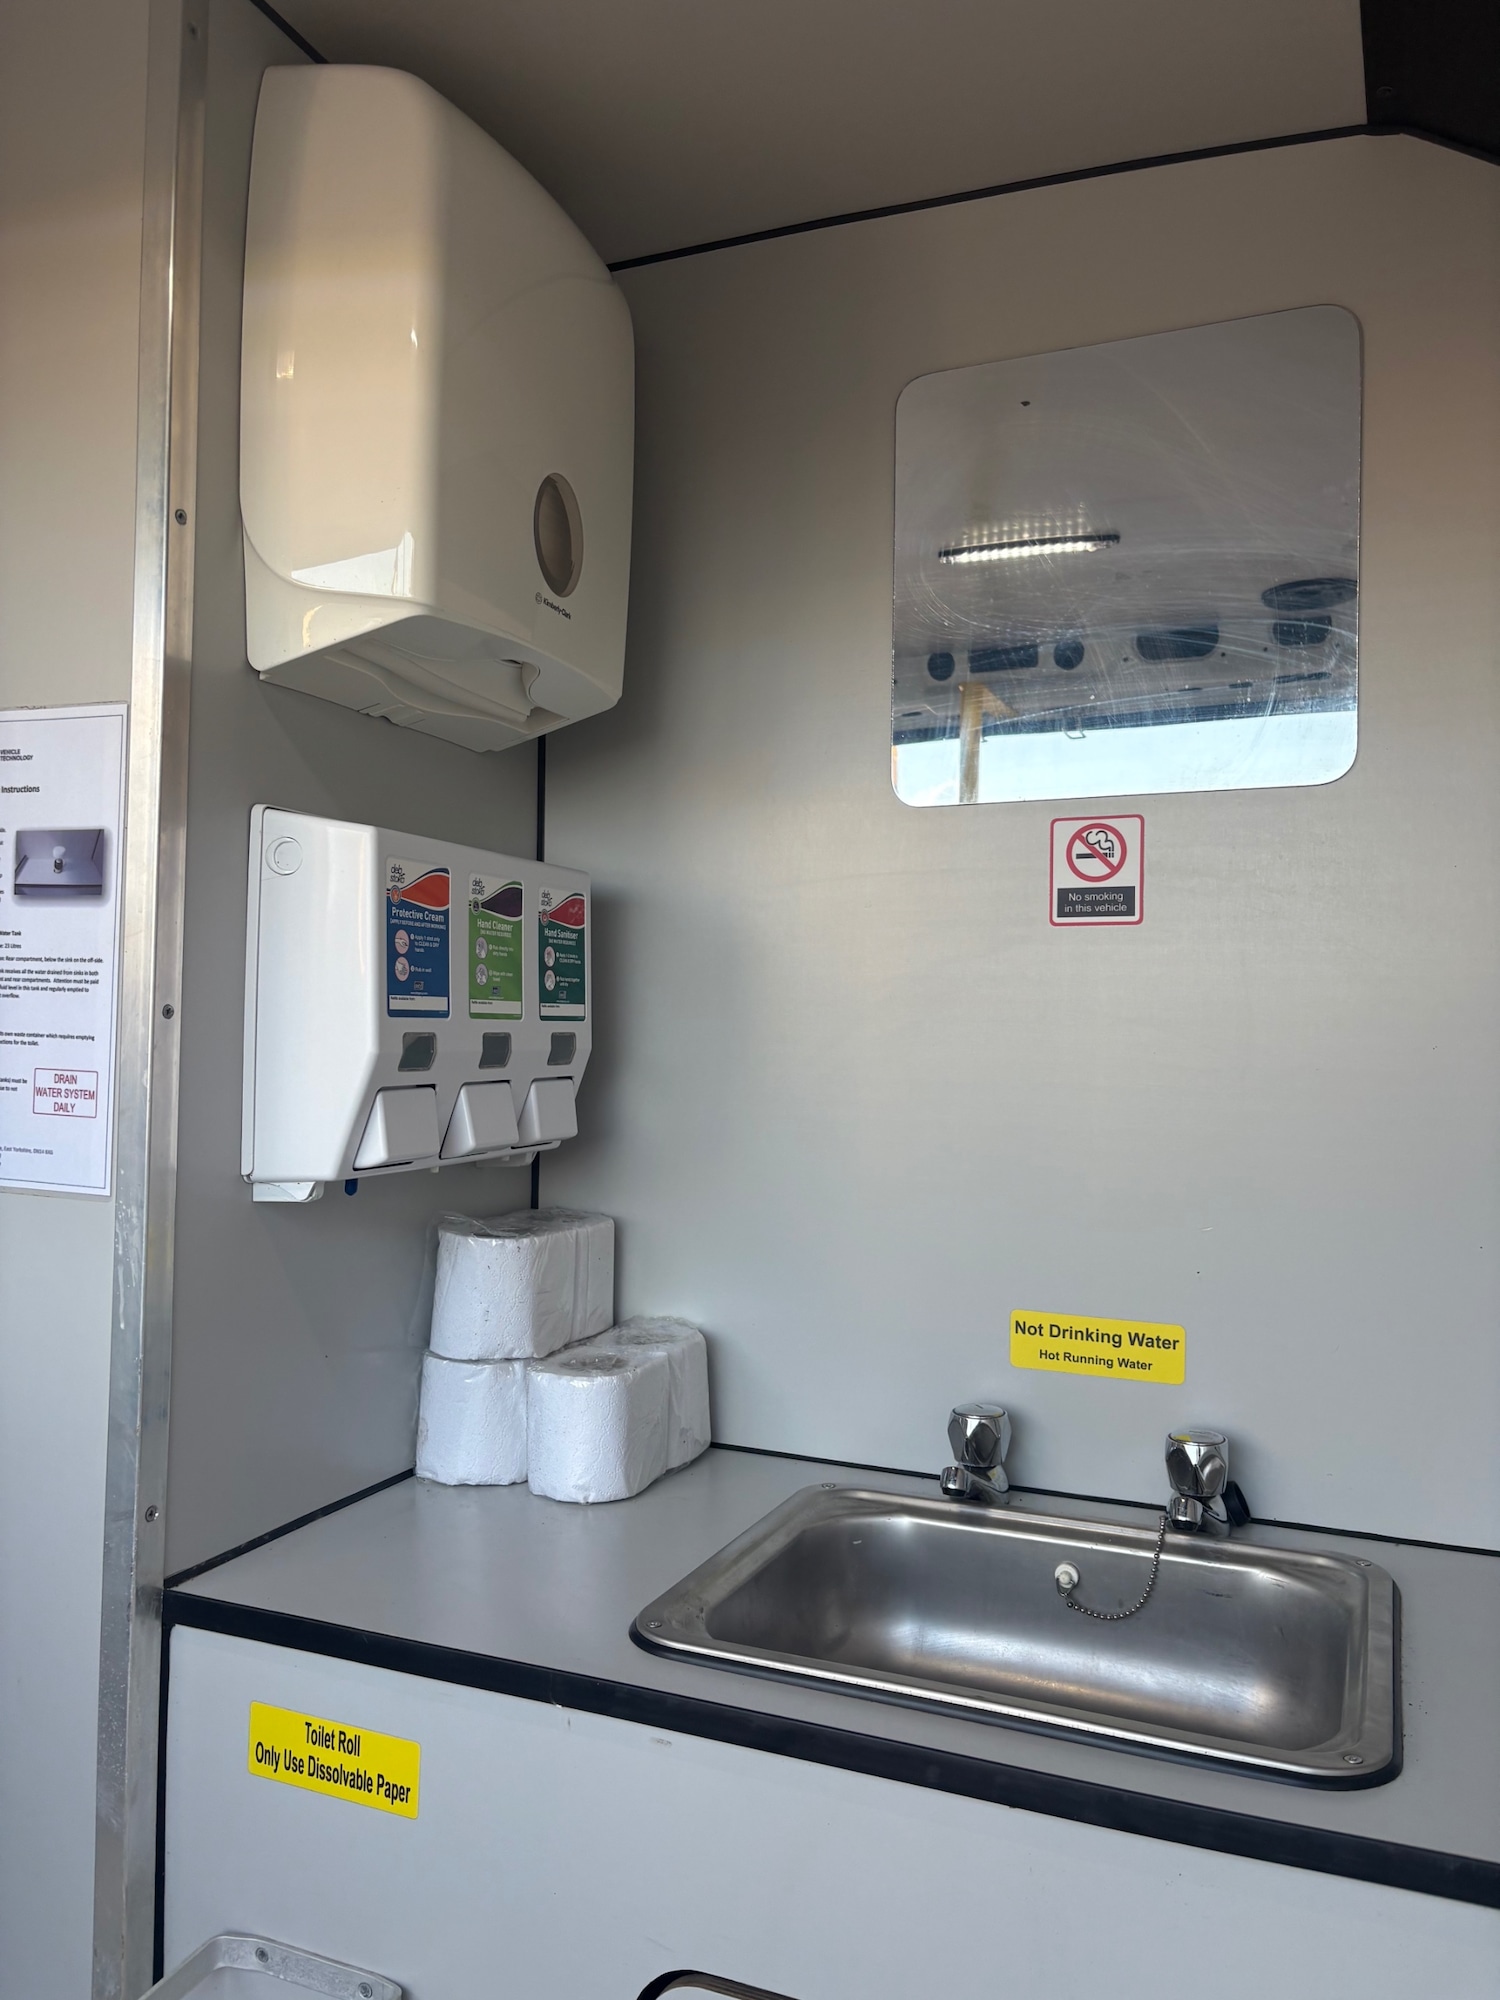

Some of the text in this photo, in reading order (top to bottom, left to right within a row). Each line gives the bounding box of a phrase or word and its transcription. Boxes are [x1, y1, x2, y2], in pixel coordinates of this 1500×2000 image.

[2, 785, 40, 793] Instructions
[391, 864, 403, 874] deb
[1068, 891, 1124, 903] No smoking
[1064, 903, 1128, 913] in this vehicle
[392, 907, 445, 923] Protective Cream
[477, 919, 514, 931] Hand Cleaner
[544, 928, 578, 940] Hand Sanitiser
[54, 1073, 77, 1084] DRAIN
[36, 1087, 94, 1100] WATER SYSTEM
[54, 1102, 76, 1113] DAILY
[1014, 1320, 1180, 1350] Not Drinking Water
[1039, 1349, 1153, 1371] Hot Running Water
[305, 1721, 361, 1757] Toilet Roll
[255, 1741, 411, 1805] Only Use Dissolvable Paper
